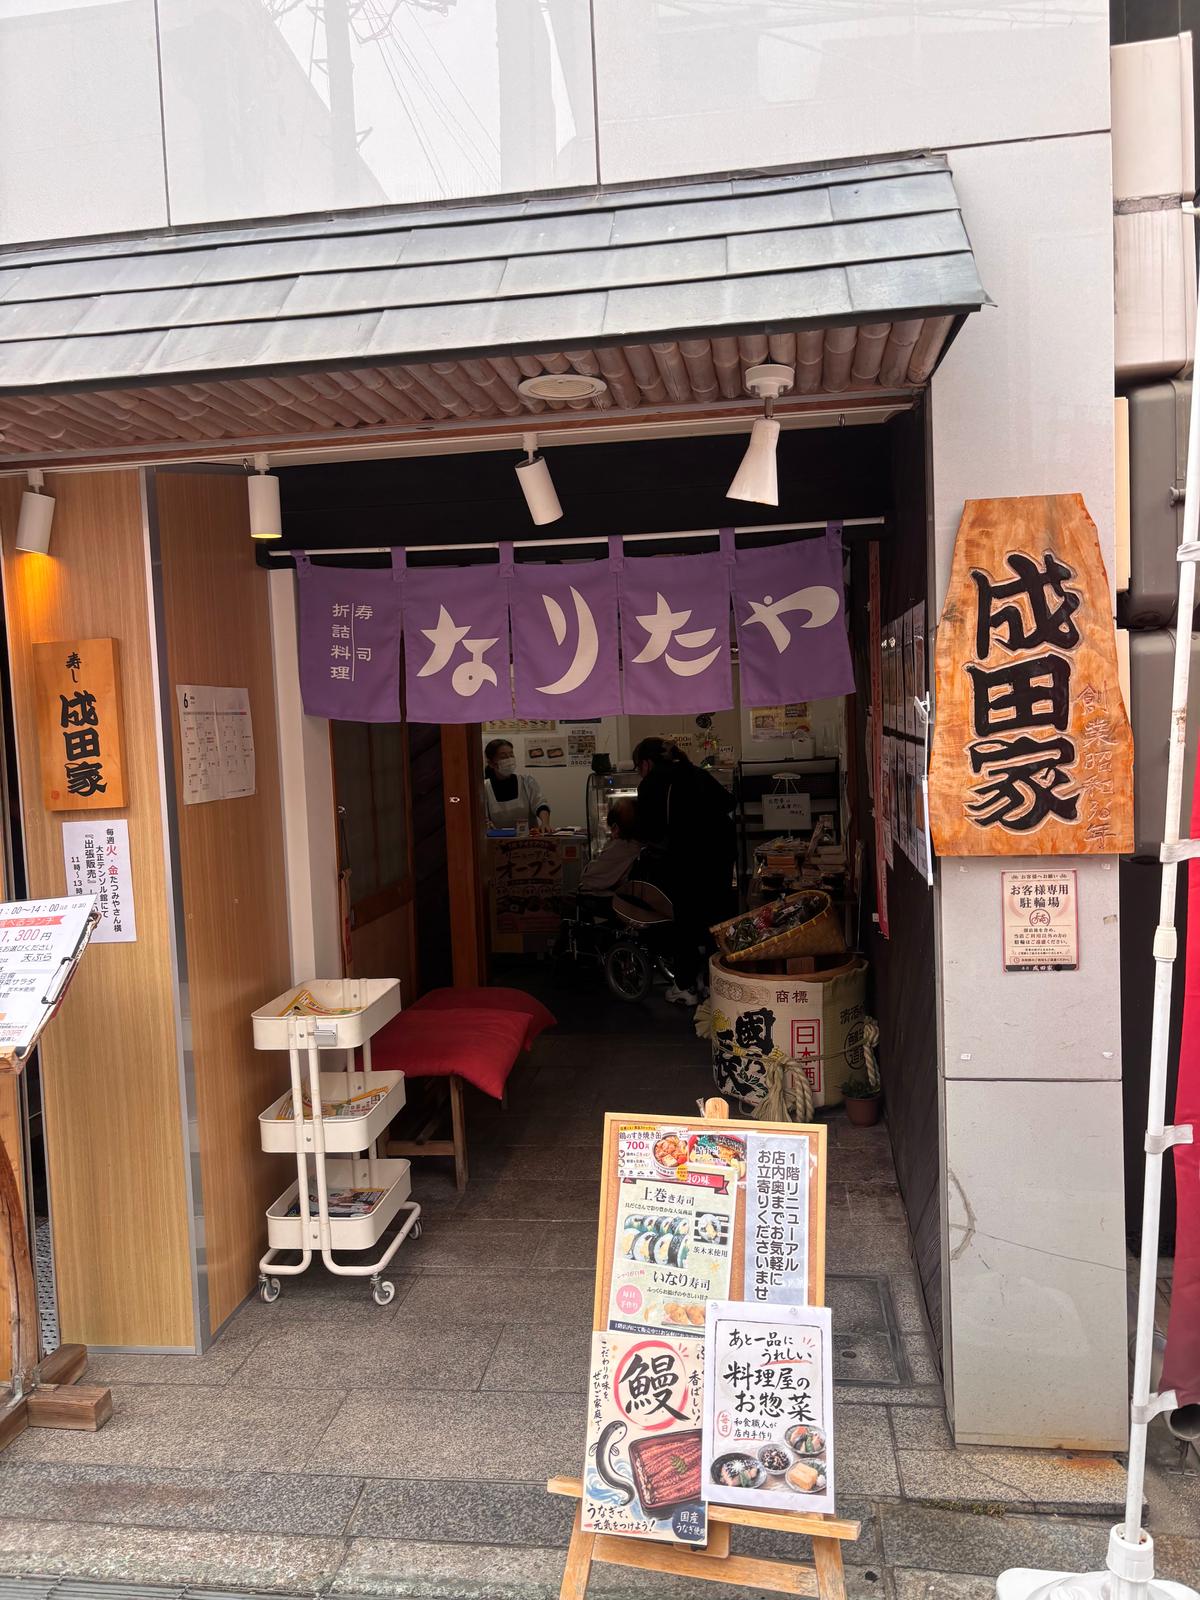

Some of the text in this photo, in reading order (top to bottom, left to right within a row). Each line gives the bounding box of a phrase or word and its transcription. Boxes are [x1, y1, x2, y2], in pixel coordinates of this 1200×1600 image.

[330, 603, 351, 680] 折詰料理
[354, 604, 374, 662] 寿司
[416, 585, 840, 697] なりたや
[183, 693, 189, 708] 6
[967, 553, 1083, 832] 成田家
[59, 690, 107, 797] 成田家
[1010, 884, 1069, 896] お客様専用
[1019, 896, 1060, 908] 駐輪場
[775, 990, 809, 1004] 商標
[640, 1187, 695, 1206] 上巻き寿司
[769, 1150, 785, 1286] 店内奥までお気軽に
[784, 1152, 800, 1272] 1階リニューアル
[754, 1150, 772, 1301] お立寄りくださいませ
[653, 1270, 710, 1290] いなり寿司
[729, 1328, 794, 1350] あと一品に
[761, 1347, 812, 1366] うれしい
[723, 1360, 810, 1391] 料理屋の
[618, 1353, 691, 1422] 鰻
[734, 1390, 817, 1422] お惣菜
[734, 1417, 777, 1429] 和食職人が
[734, 1428, 772, 1440] 店内手作り
[593, 1519, 656, 1532] 元気をつけよう!
[680, 1511, 699, 1524] 国産
